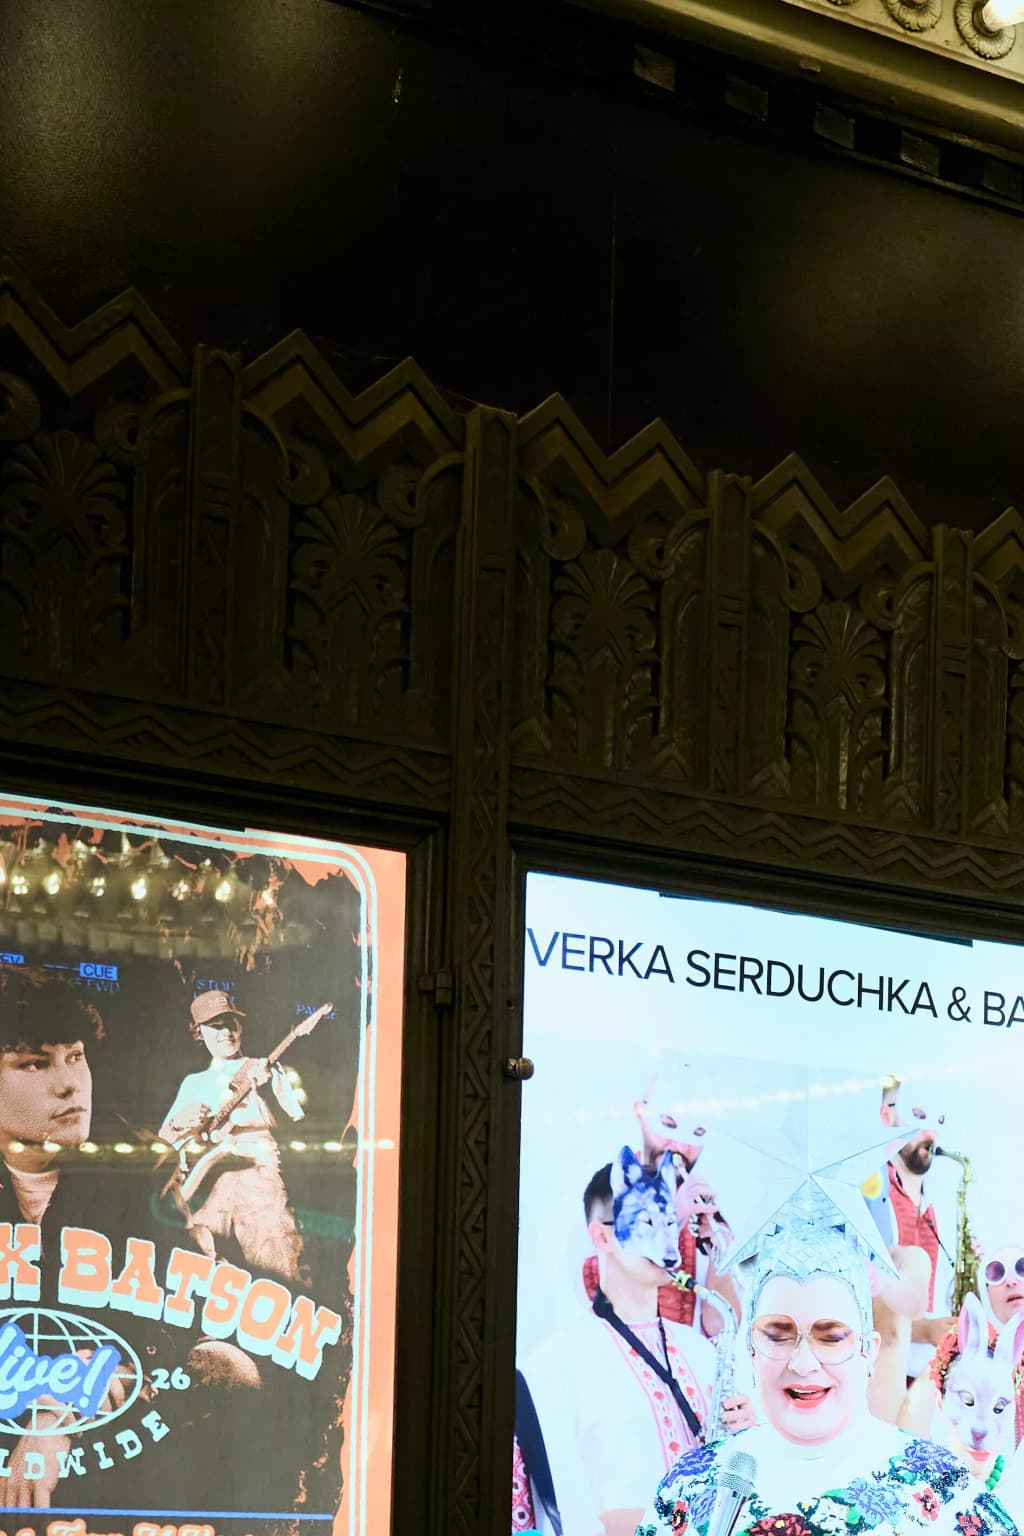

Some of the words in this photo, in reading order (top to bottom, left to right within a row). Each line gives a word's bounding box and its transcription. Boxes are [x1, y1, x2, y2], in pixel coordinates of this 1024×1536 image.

[82, 963, 115, 980] CUE
[526, 927, 675, 984] VERKA
[685, 949, 939, 1019] SERDUCHKA
[946, 986, 972, 1023] &
[58, 1226, 342, 1381] BATSON
[151, 1366, 191, 1391] 26
